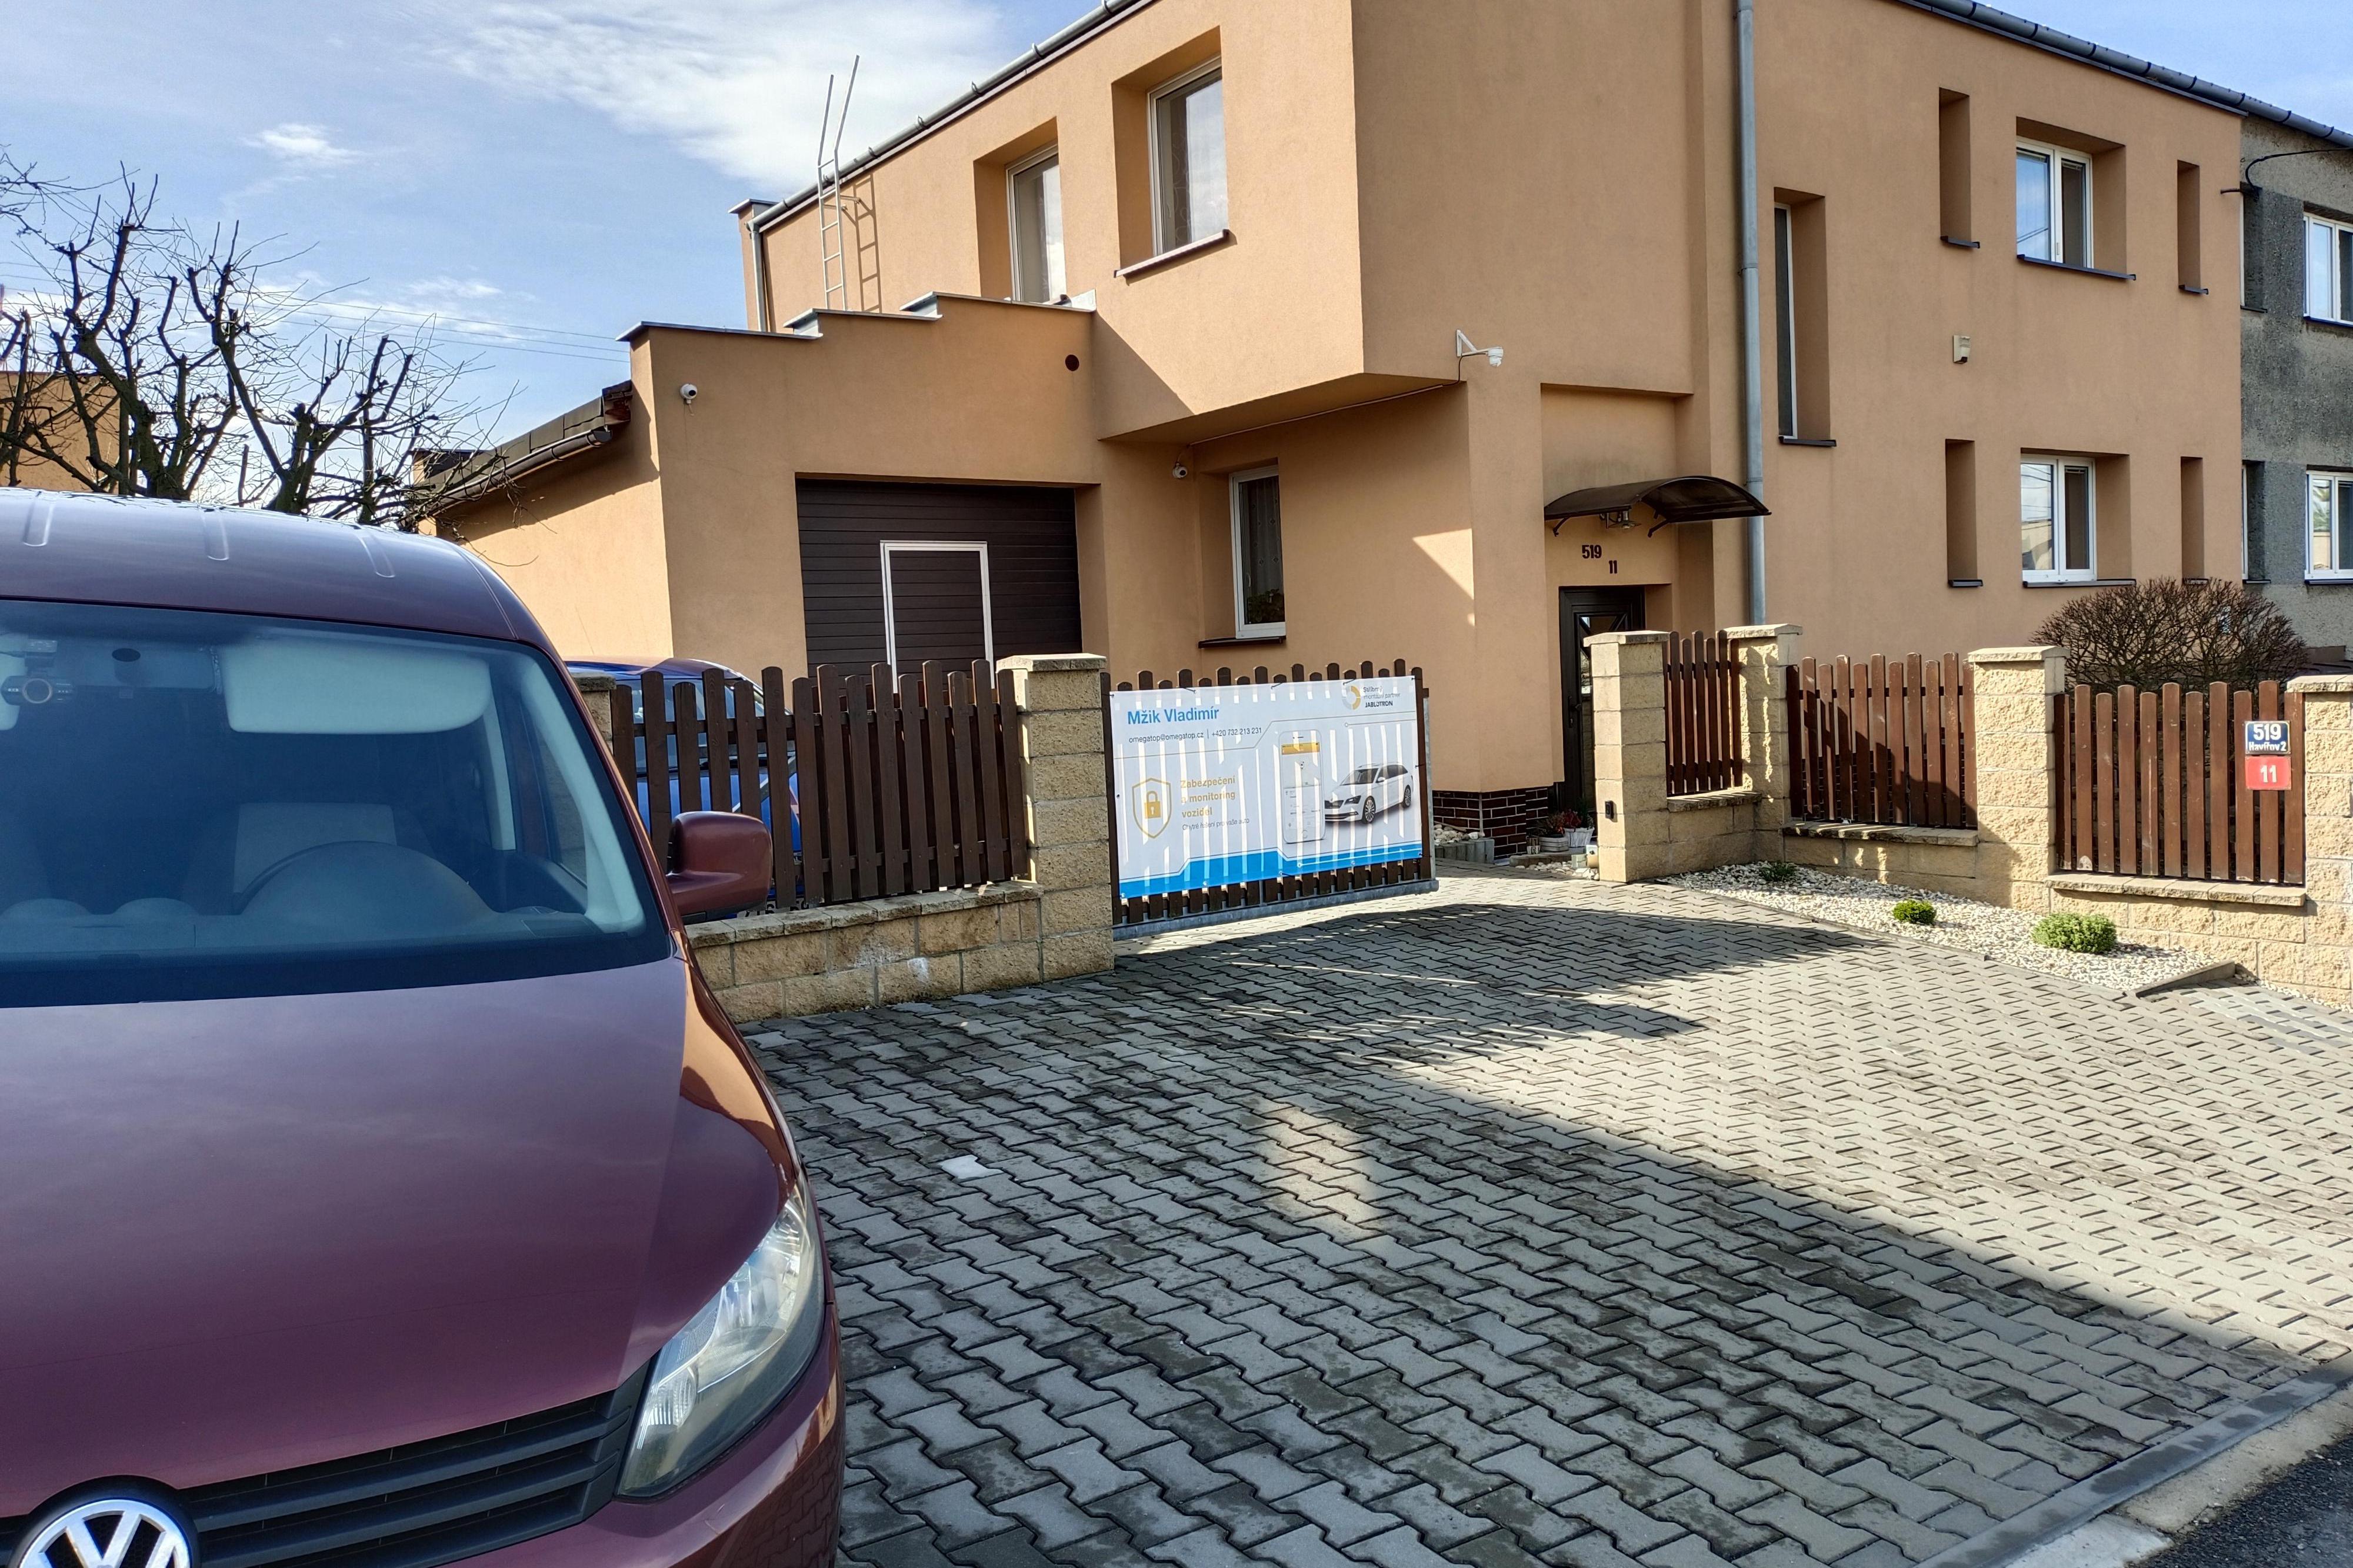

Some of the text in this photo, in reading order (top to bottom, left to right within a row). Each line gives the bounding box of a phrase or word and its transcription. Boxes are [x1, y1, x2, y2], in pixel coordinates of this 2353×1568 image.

[1582, 545, 1602, 559] 519
[1609, 560, 1617, 574] 11
[1128, 706, 1219, 725] Mžik Vladimír
[1129, 732, 1204, 744] omegatop@omegatop.cz
[2253, 723, 2281, 740] 519
[2249, 741, 2287, 751] Havířov 2
[2260, 765, 2277, 783] 11
[1181, 775, 1235, 788] Zabezpečení
[1189, 791, 1235, 802] monitoring
[1182, 807, 1212, 818] vozidel
